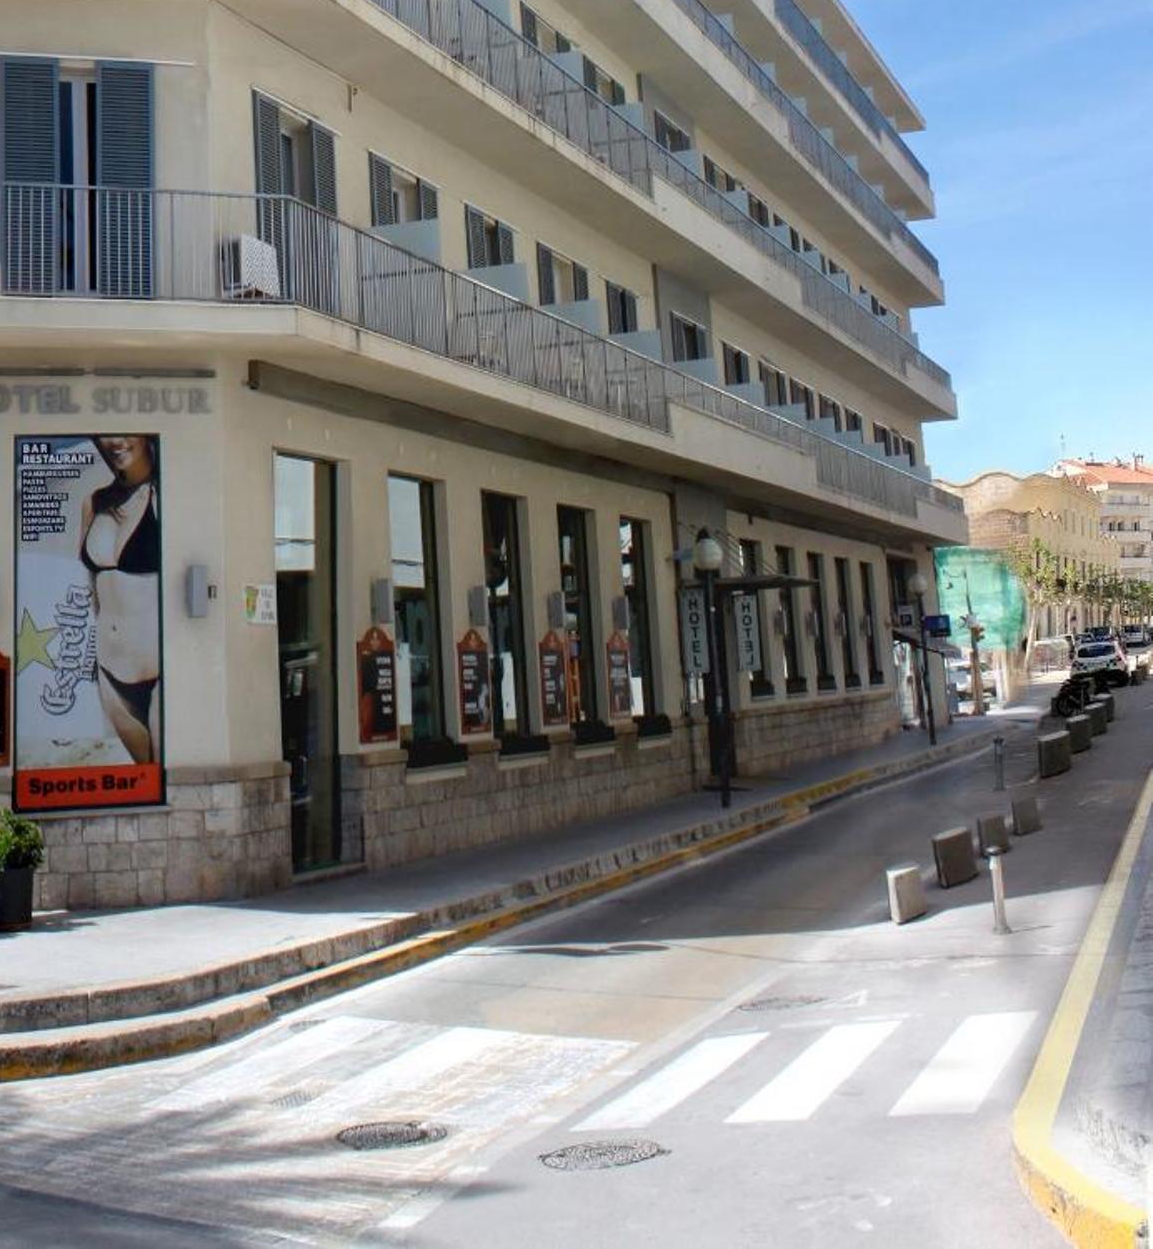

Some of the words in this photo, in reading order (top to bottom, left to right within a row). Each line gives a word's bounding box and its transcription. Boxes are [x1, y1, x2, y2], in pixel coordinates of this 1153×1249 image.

[91, 386, 214, 415] SUBUR
[22, 443, 48, 454] BAR
[22, 453, 93, 464] RESTAURANT
[689, 599, 702, 668] HOTEL
[40, 585, 93, 715] Estrella
[28, 777, 97, 797] Sports
[101, 773, 139, 791] Bar
